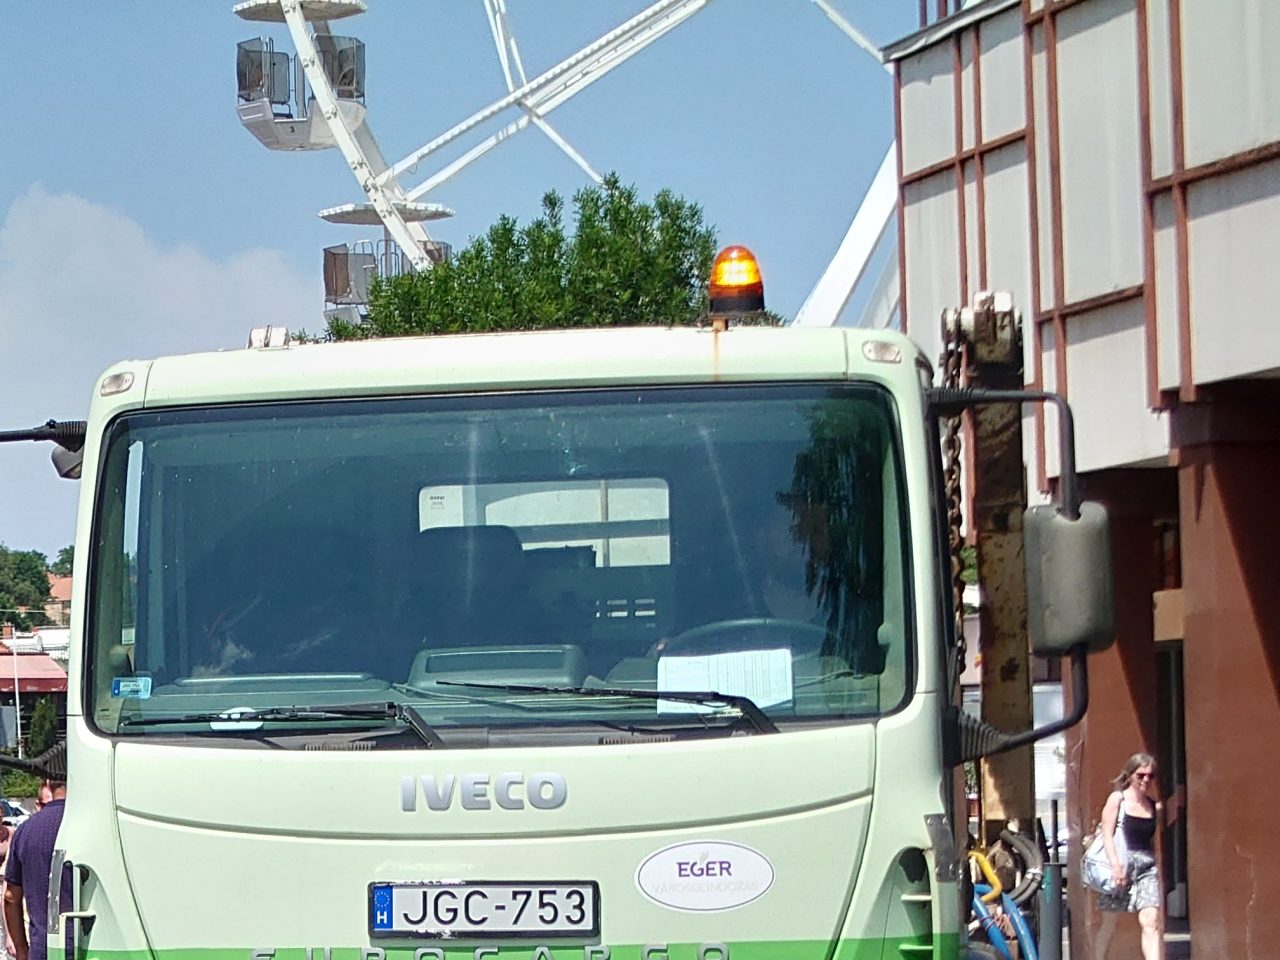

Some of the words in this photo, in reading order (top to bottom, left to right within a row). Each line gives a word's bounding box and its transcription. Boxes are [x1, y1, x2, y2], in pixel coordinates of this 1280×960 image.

[401, 771, 568, 812] IVECO
[677, 860, 732, 878] EGER
[376, 911, 388, 924] H
[402, 889, 586, 926] JGC-753
